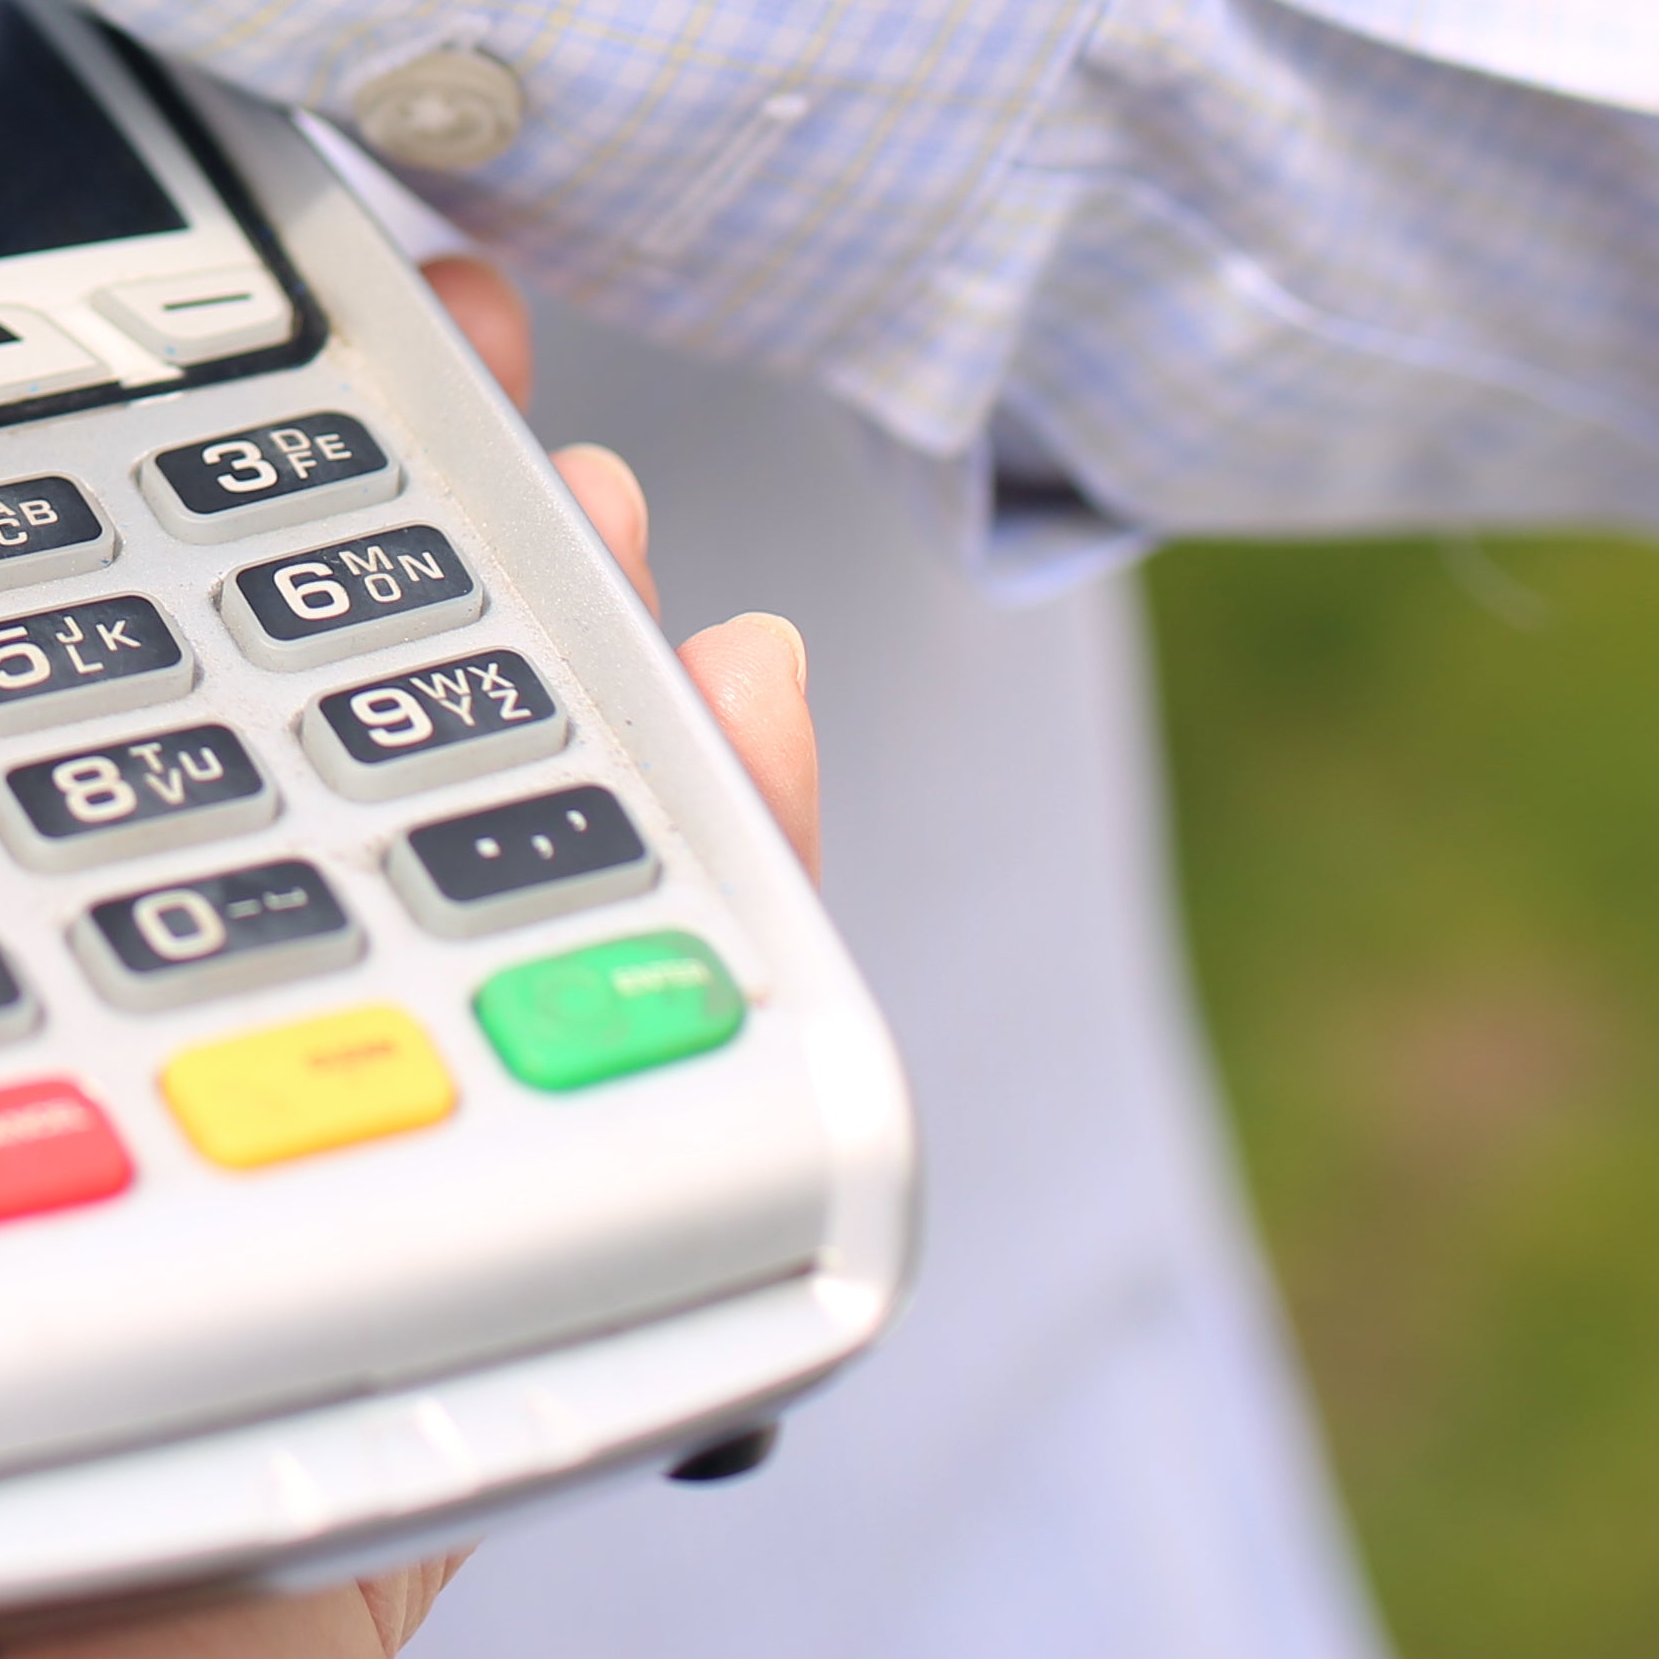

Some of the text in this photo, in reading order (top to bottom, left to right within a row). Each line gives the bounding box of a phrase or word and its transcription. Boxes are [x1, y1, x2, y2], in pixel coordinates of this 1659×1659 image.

[202, 441, 278, 492] 3
[273, 562, 351, 620] 6
[350, 687, 434, 748] 9
[52, 755, 140, 824] 8
[132, 888, 229, 961] 0
